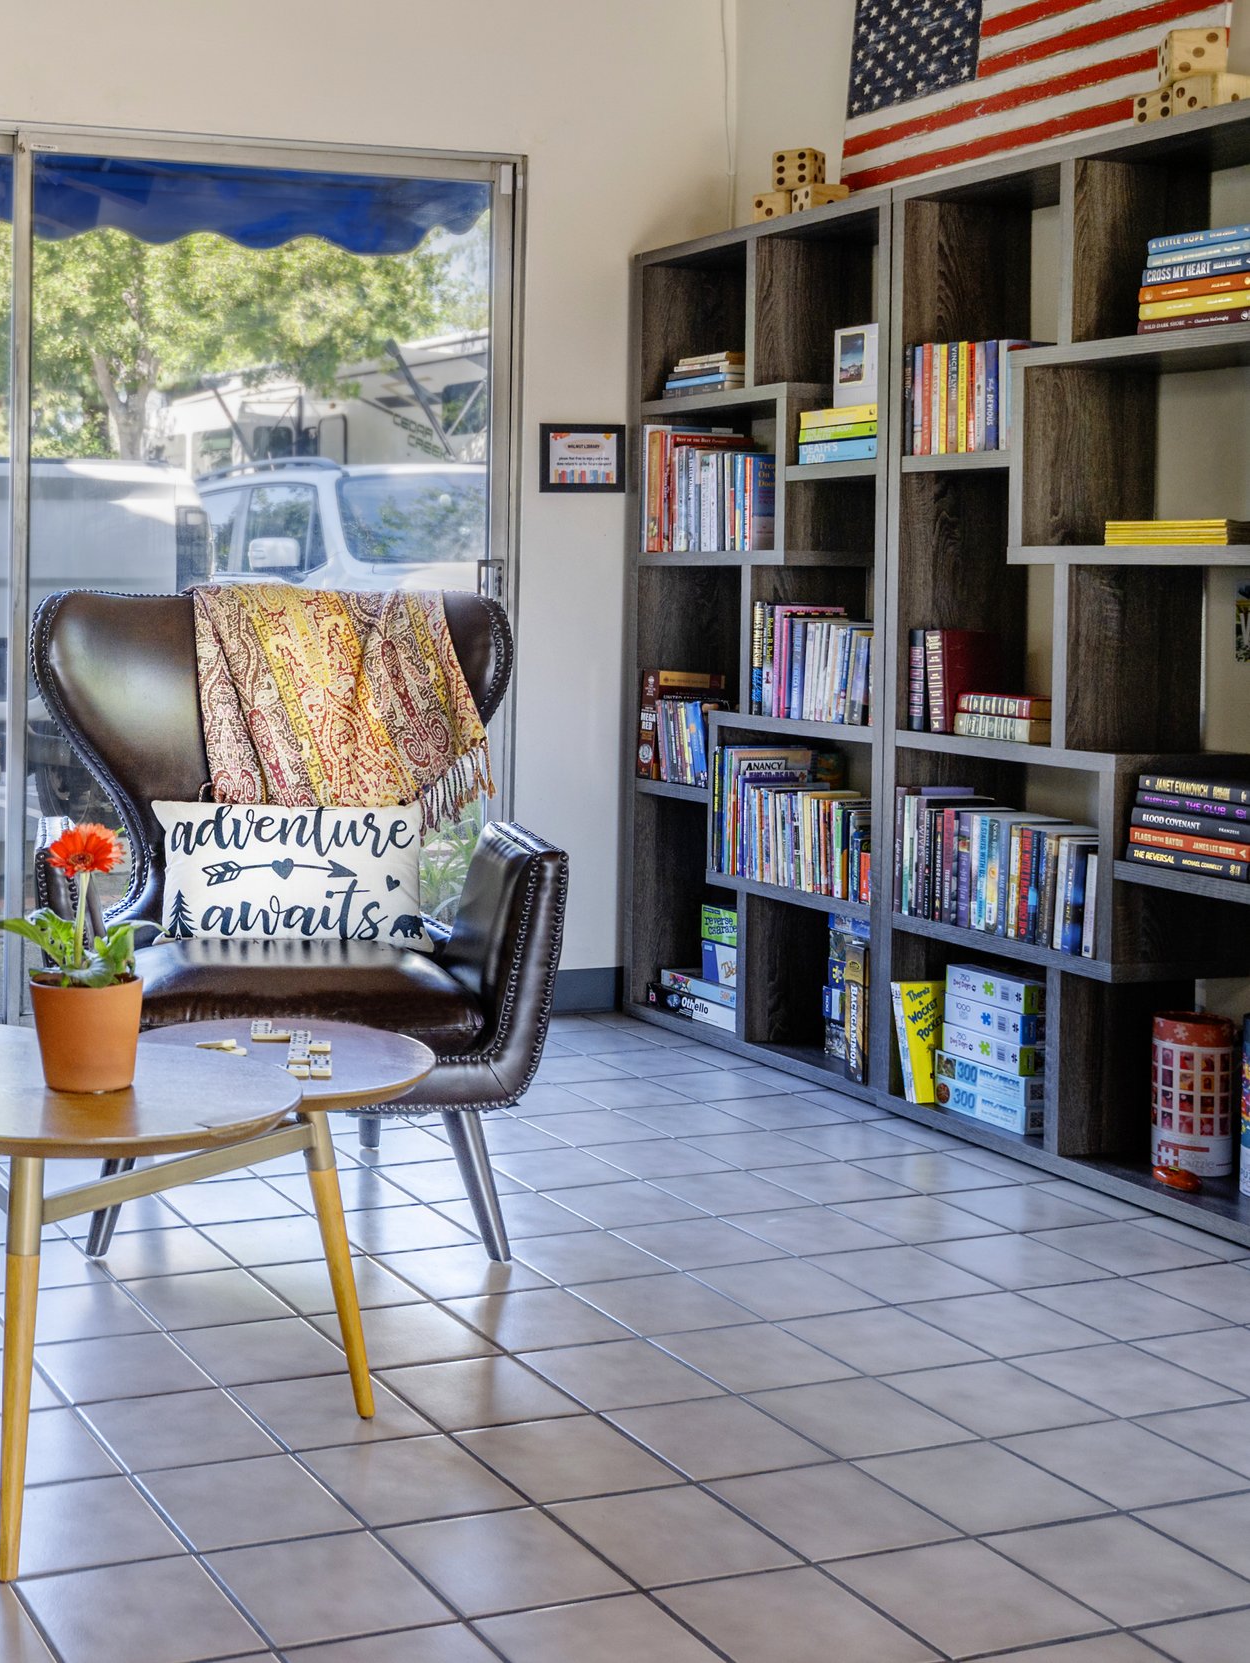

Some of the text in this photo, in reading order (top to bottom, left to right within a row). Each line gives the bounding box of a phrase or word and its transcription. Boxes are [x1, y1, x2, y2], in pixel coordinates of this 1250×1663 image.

[1159, 238, 1181, 247] LITTLE
[1183, 234, 1204, 243] HOPE
[1147, 262, 1212, 282] CROSS MY HEART
[986, 394, 994, 426] DEVIOUS
[393, 412, 434, 440] CEDAR
[801, 442, 838, 456] DEATH'S
[806, 453, 825, 464] END
[753, 630, 763, 668] PATTERSON
[640, 712, 656, 722] MEGA
[641, 721, 653, 730] RED
[746, 762, 783, 770] ANANCY
[1155, 778, 1174, 792] JANET
[1174, 780, 1209, 797] EVANOVICH
[1185, 801, 1227, 816] THE CLUB
[171, 805, 414, 857] adventure
[1142, 813, 1165, 823] BLOOD
[1165, 817, 1201, 831] COVENANT
[1022, 838, 1031, 851] DARK
[1134, 831, 1151, 842] FLAGS
[1165, 836, 1184, 847] BAYOU
[1192, 842, 1209, 851] JAMES
[1209, 844, 1218, 852] LEE
[1021, 853, 1031, 873] MATTER
[1133, 849, 1145, 859] THE
[1145, 852, 1175, 864] REVERSAL
[1181, 859, 1201, 868] MICHAEL
[979, 870, 986, 878] US
[200, 879, 388, 940] awaits
[705, 916, 733, 926] reverse
[960, 973, 970, 982] 750
[681, 996, 709, 1014] Othello
[907, 997, 938, 1025] WOCKET
[956, 1002, 971, 1013] 1000
[850, 983, 858, 1069] BACKGAMMON
[916, 1014, 944, 1042] POCKET
[958, 1061, 978, 1083] 300
[953, 1088, 976, 1109] 300
